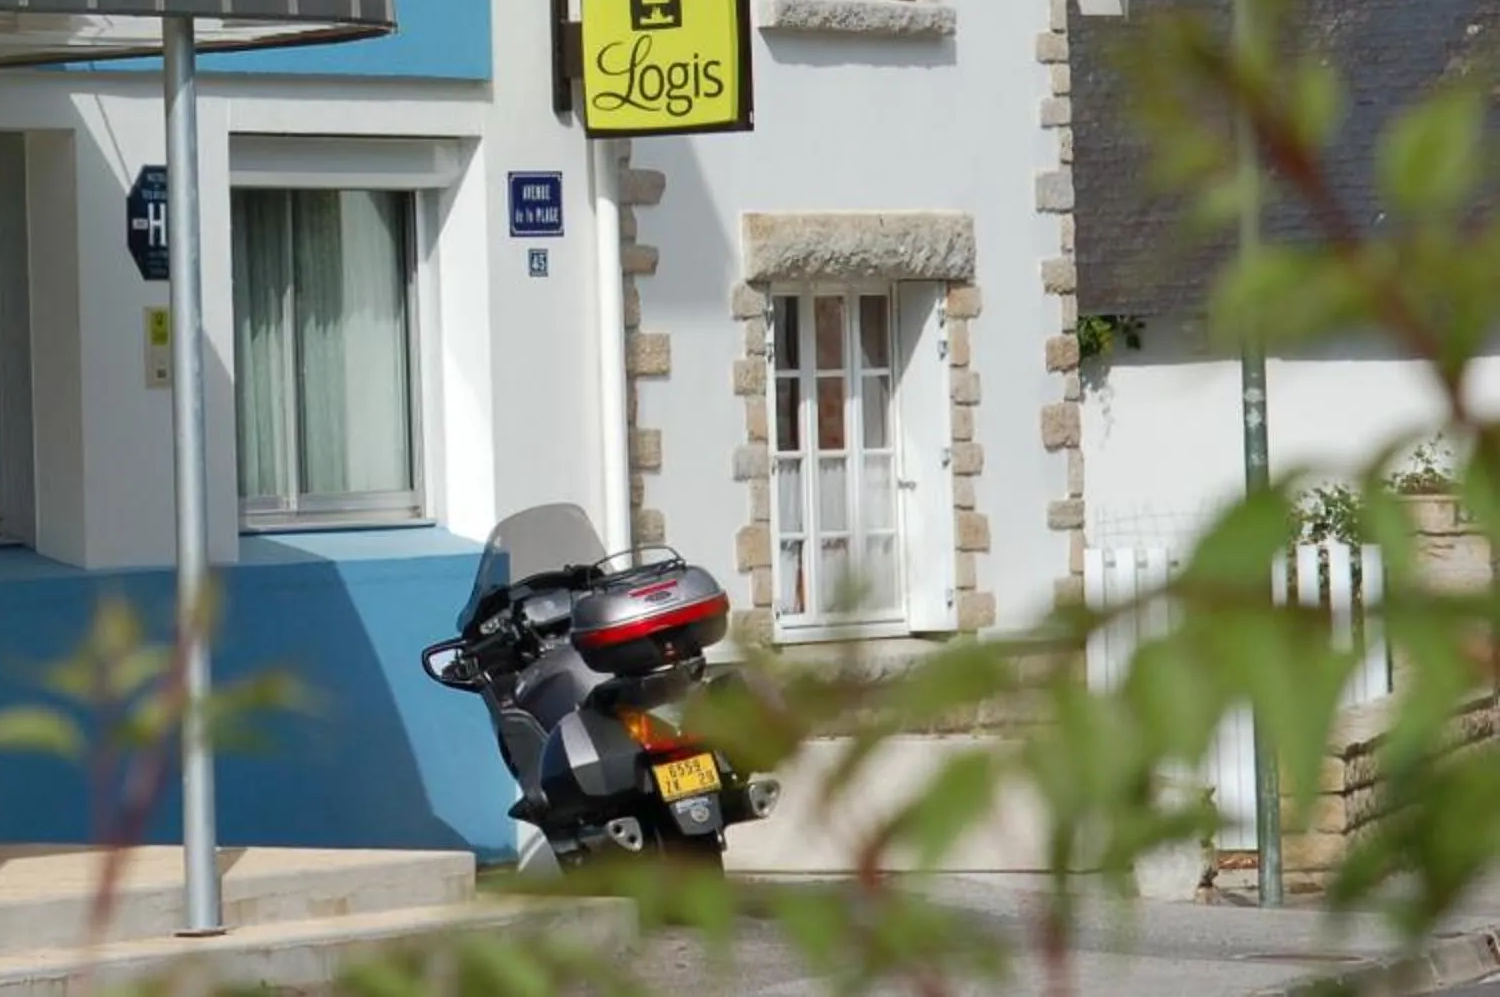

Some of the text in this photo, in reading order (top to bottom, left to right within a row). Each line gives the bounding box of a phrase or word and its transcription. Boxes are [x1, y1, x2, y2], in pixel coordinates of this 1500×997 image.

[592, 34, 724, 117] Logis
[522, 184, 551, 201] AVENUE
[149, 203, 167, 247] H
[535, 207, 560, 223] PLAGE
